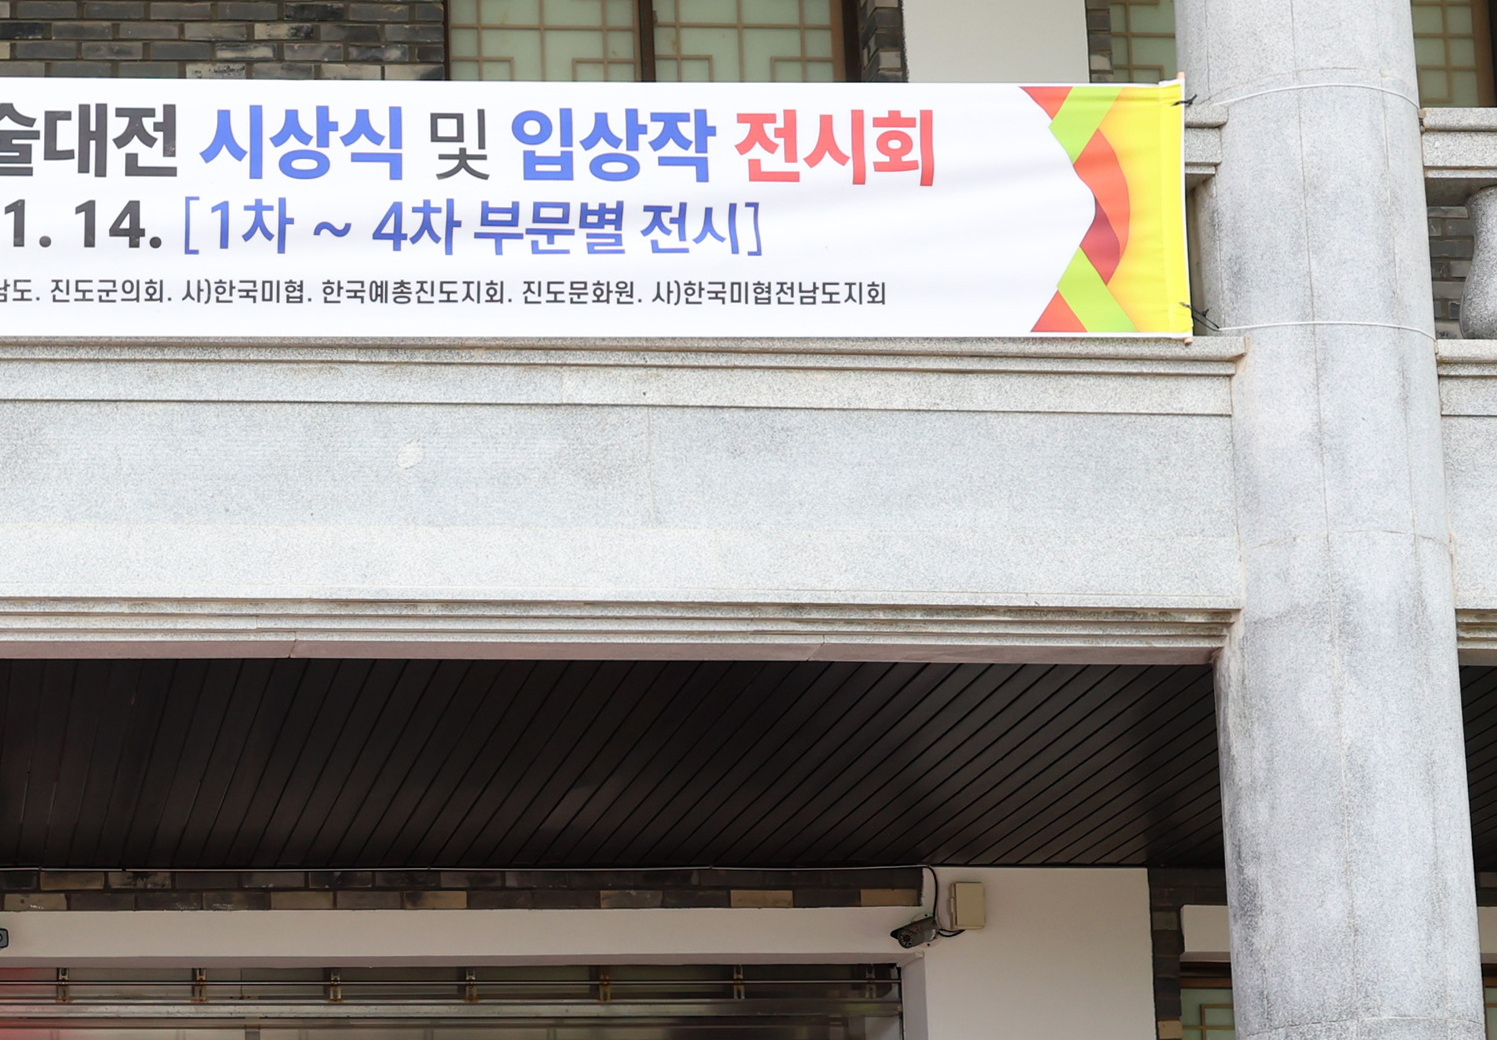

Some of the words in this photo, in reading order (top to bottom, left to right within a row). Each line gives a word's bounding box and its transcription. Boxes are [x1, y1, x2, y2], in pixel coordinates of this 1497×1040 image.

[200, 104, 402, 181] 시상식
[430, 108, 489, 181] 및
[512, 107, 716, 183] 입상작
[735, 109, 934, 187] 전시회
[75, 199, 162, 249] 14.
[185, 197, 294, 256] [1차
[313, 221, 351, 238] ~
[372, 199, 462, 256] 4차
[474, 200, 625, 256] 부문별
[641, 201, 762, 257] 전시]
[51, 279, 172, 304] 진도군의회.
[182, 279, 313, 305] 사)한국미협.
[322, 280, 513, 305] 한국예총진도지회.
[523, 280, 643, 305] 진도문화원.
[652, 280, 886, 306] 사)한국미협전남도지회
